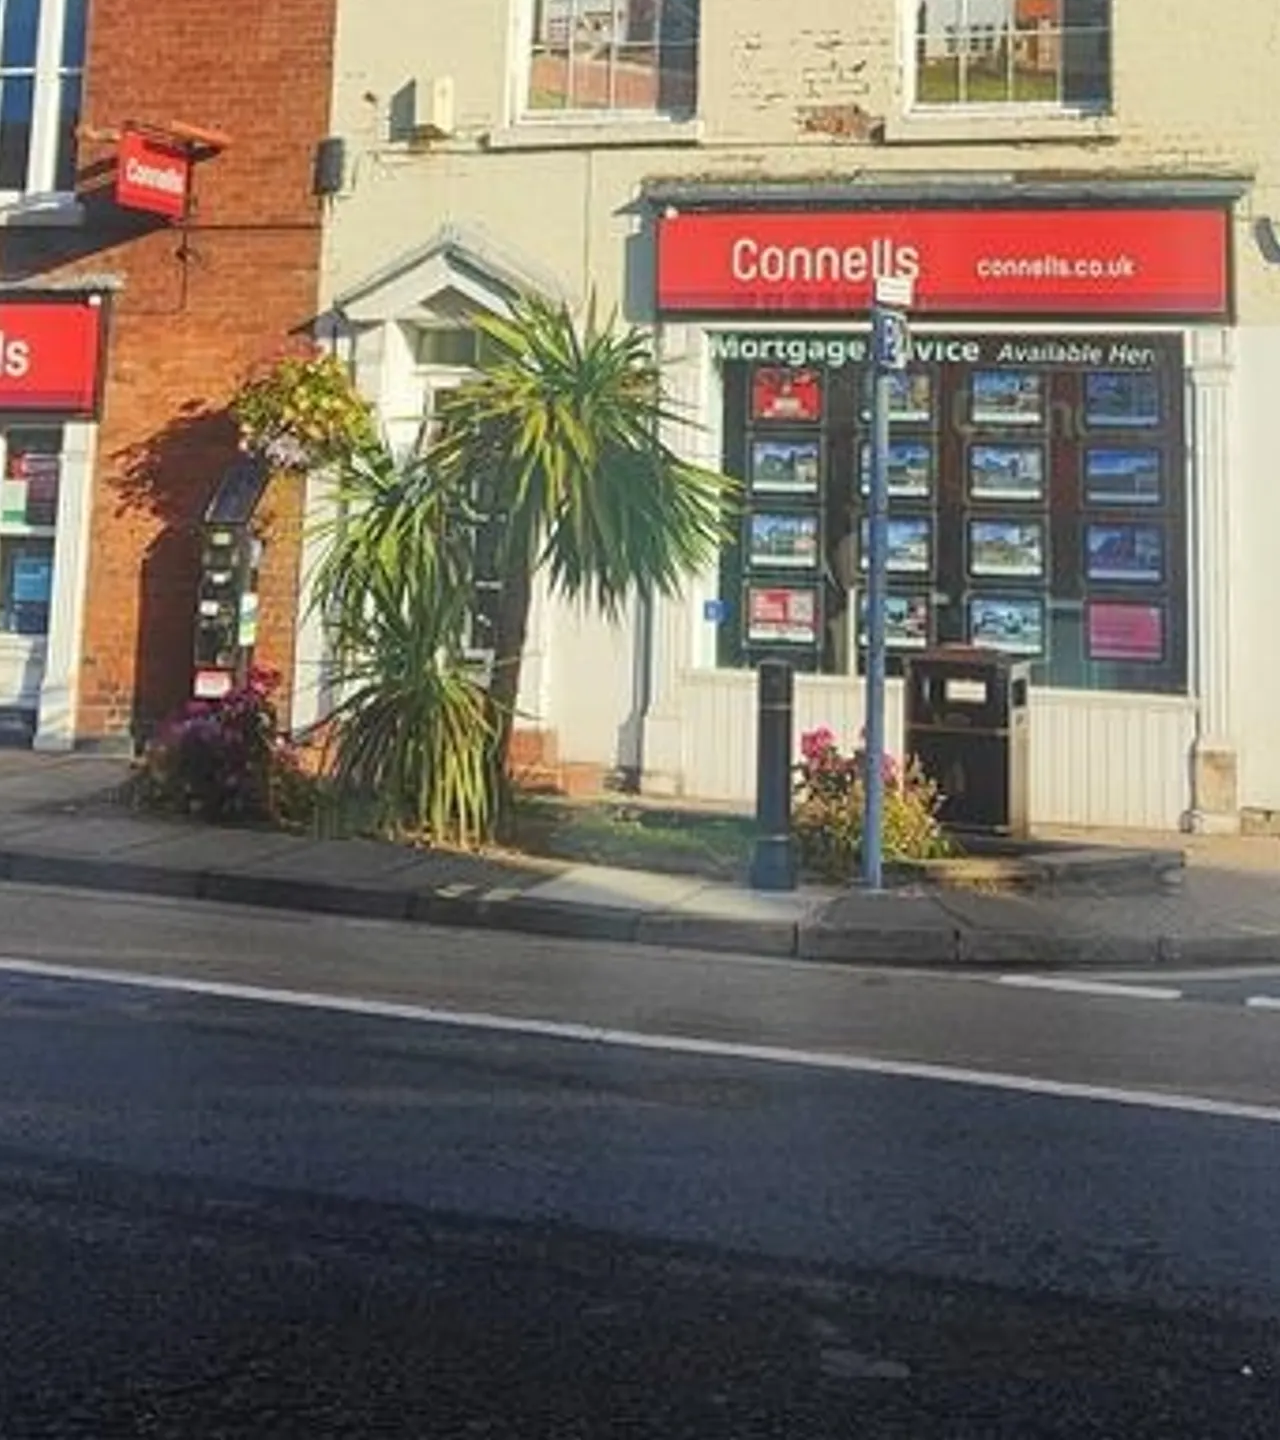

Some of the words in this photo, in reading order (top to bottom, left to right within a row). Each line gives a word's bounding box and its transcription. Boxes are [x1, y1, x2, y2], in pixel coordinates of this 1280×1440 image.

[125, 157, 184, 193] Connells
[732, 237, 919, 281] Connells
[976, 254, 1136, 278] connells.co.uk
[708, 335, 867, 365] Mortgage
[997, 342, 1103, 363] Available
